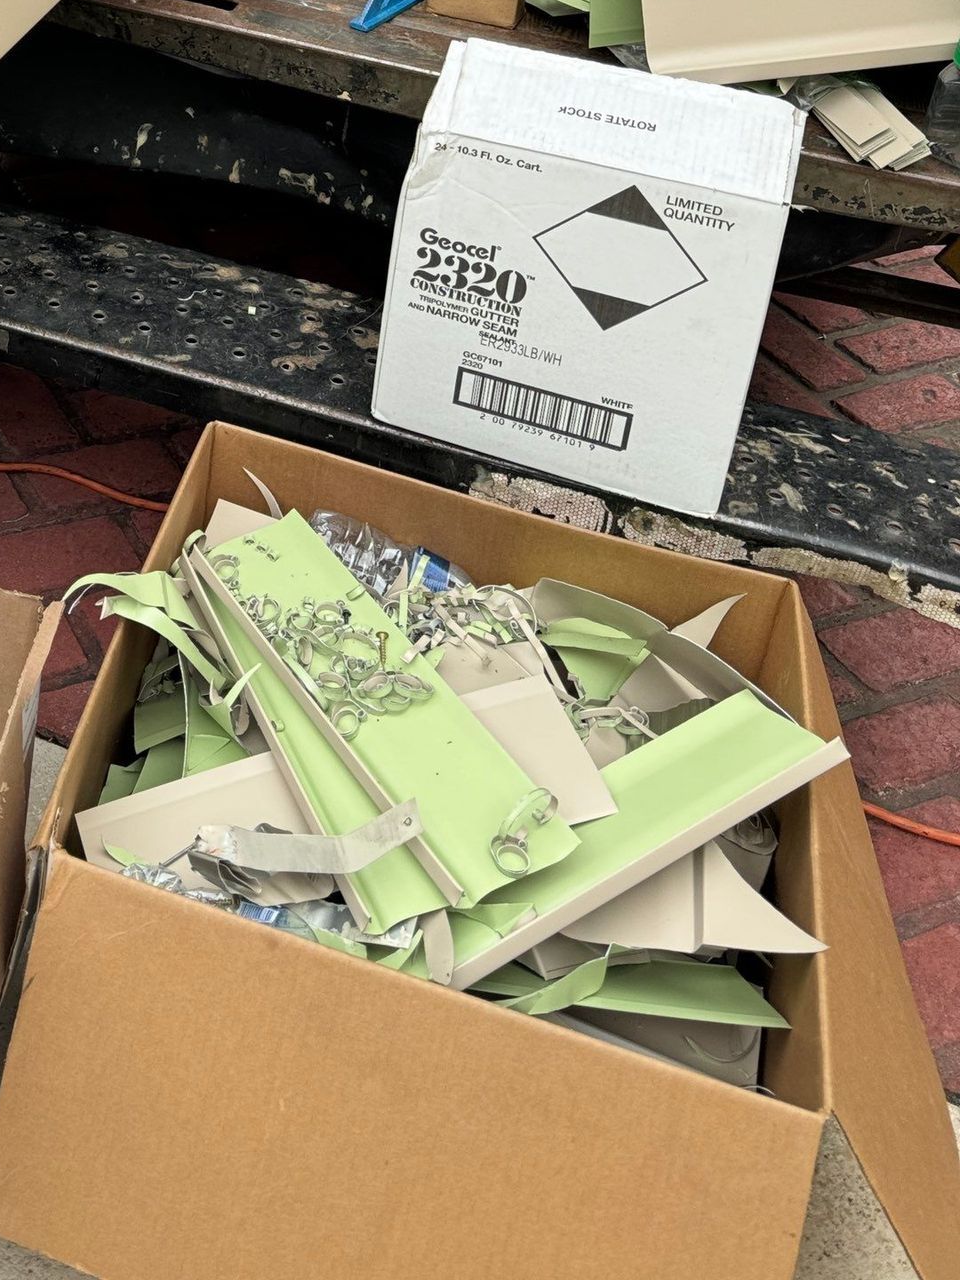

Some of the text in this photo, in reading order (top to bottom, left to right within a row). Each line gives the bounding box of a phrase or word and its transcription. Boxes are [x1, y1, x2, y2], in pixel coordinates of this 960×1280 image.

[558, 106, 657, 132] ROTATE STOCK
[434, 142, 447, 151] 24
[457, 145, 478, 157] 10.3
[480, 150, 493, 161] Fl.
[496, 154, 513, 166] Oz.
[516, 159, 543, 173] Cart.
[666, 195, 723, 216] LIMITED
[663, 207, 735, 232] QUANTITY
[410, 277, 522, 317] CONSTRUCTION
[408, 301, 517, 337] AND NARROW SEAM
[419, 294, 520, 327] TRIPOLYMER GUTTER
[478, 330, 516, 346] SEALANT
[480, 335, 562, 367] ER2933LB/WH
[461, 358, 483, 370] 2320
[463, 350, 503, 367] GC67101
[601, 396, 634, 411] WHITE
[492, 417, 505, 426] 00
[511, 421, 544, 436] 79239
[549, 433, 582, 448] 67101
